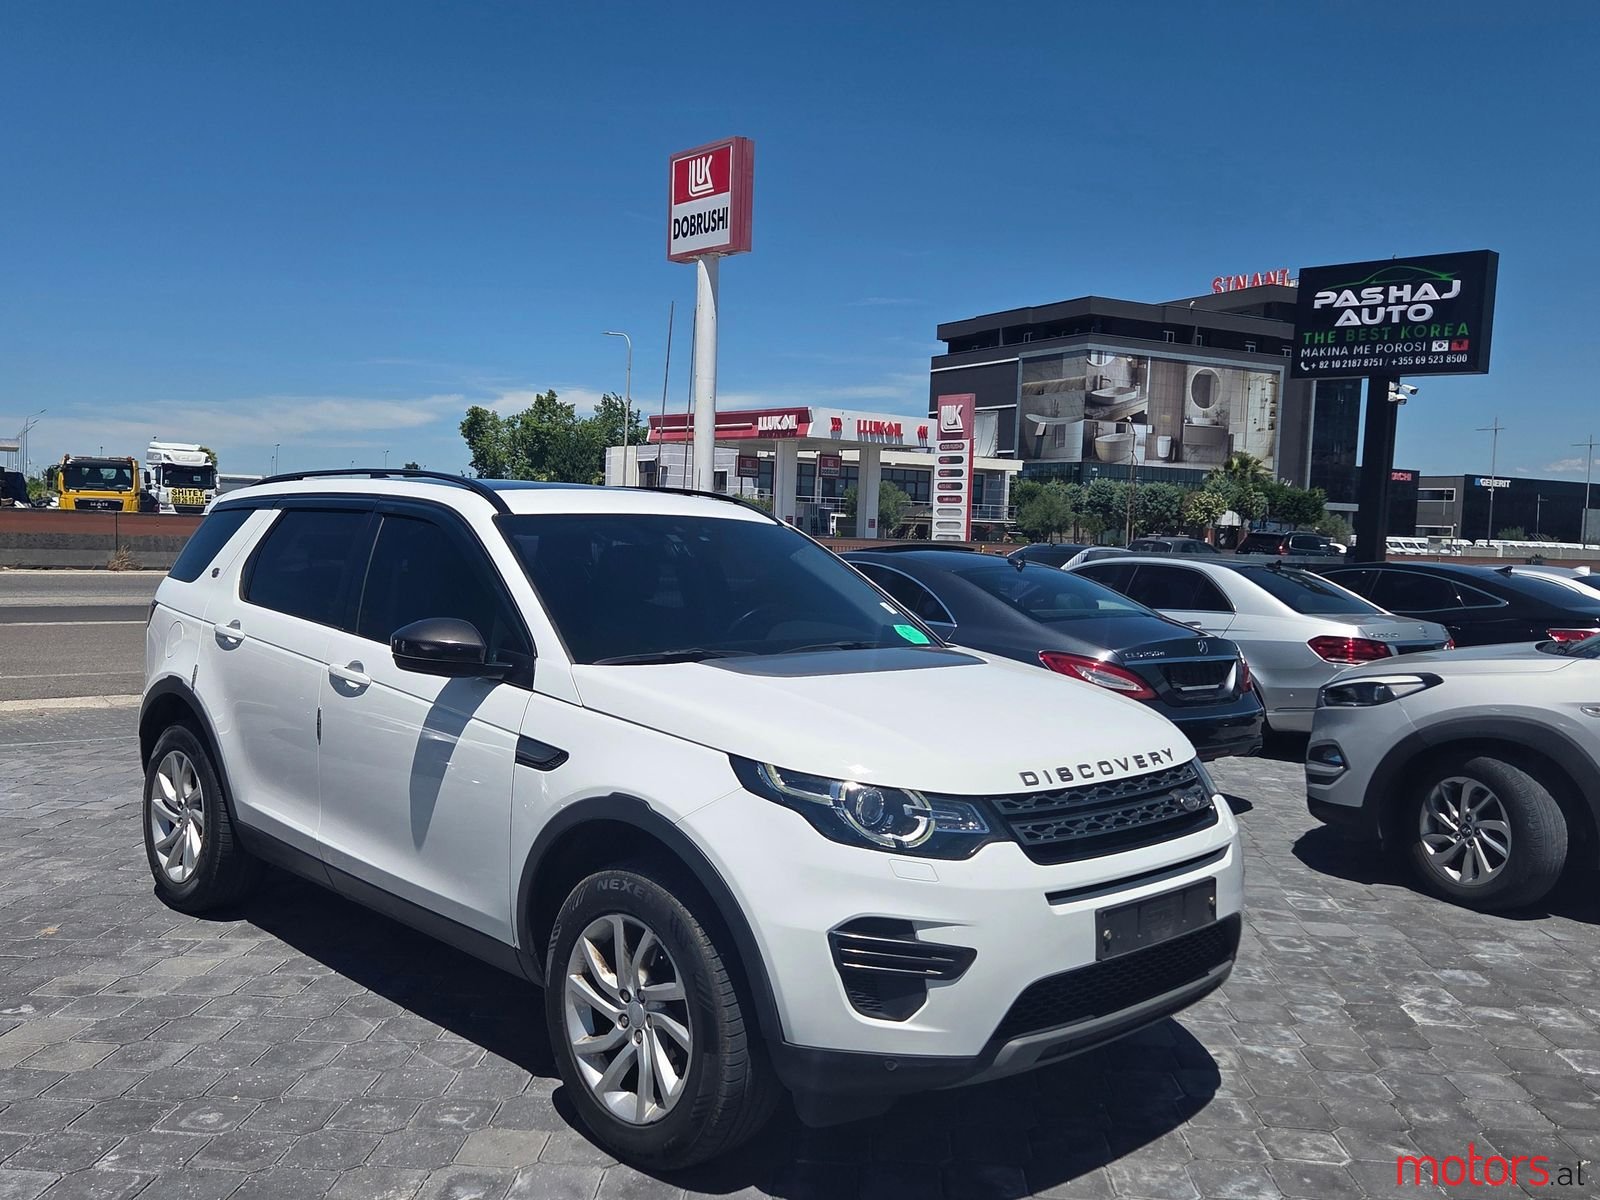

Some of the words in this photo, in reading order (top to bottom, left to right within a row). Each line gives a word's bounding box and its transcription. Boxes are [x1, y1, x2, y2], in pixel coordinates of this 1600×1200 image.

[673, 206, 729, 240] DOBRUSHI
[1313, 279, 1461, 309] PASHAJ
[1334, 303, 1434, 327] AUTO
[1303, 330, 1337, 345] THE
[1346, 326, 1392, 343] BEST
[1400, 322, 1469, 340] KOREA
[1301, 344, 1349, 358] MAKINA
[1353, 343, 1371, 355] ME
[1376, 341, 1426, 354] POROSI
[1319, 360, 1329, 369] 82
[1331, 359, 1341, 368] 10
[1342, 358, 1361, 367] 2187
[1363, 357, 1383, 366] 8751
[1391, 356, 1413, 366] +355
[1415, 355, 1426, 365] 69
[1428, 355, 1444, 364] 523
[1446, 354, 1468, 363] 8500
[171, 488, 204, 497] SHITET
[1019, 747, 1175, 787] DISCOVERY
